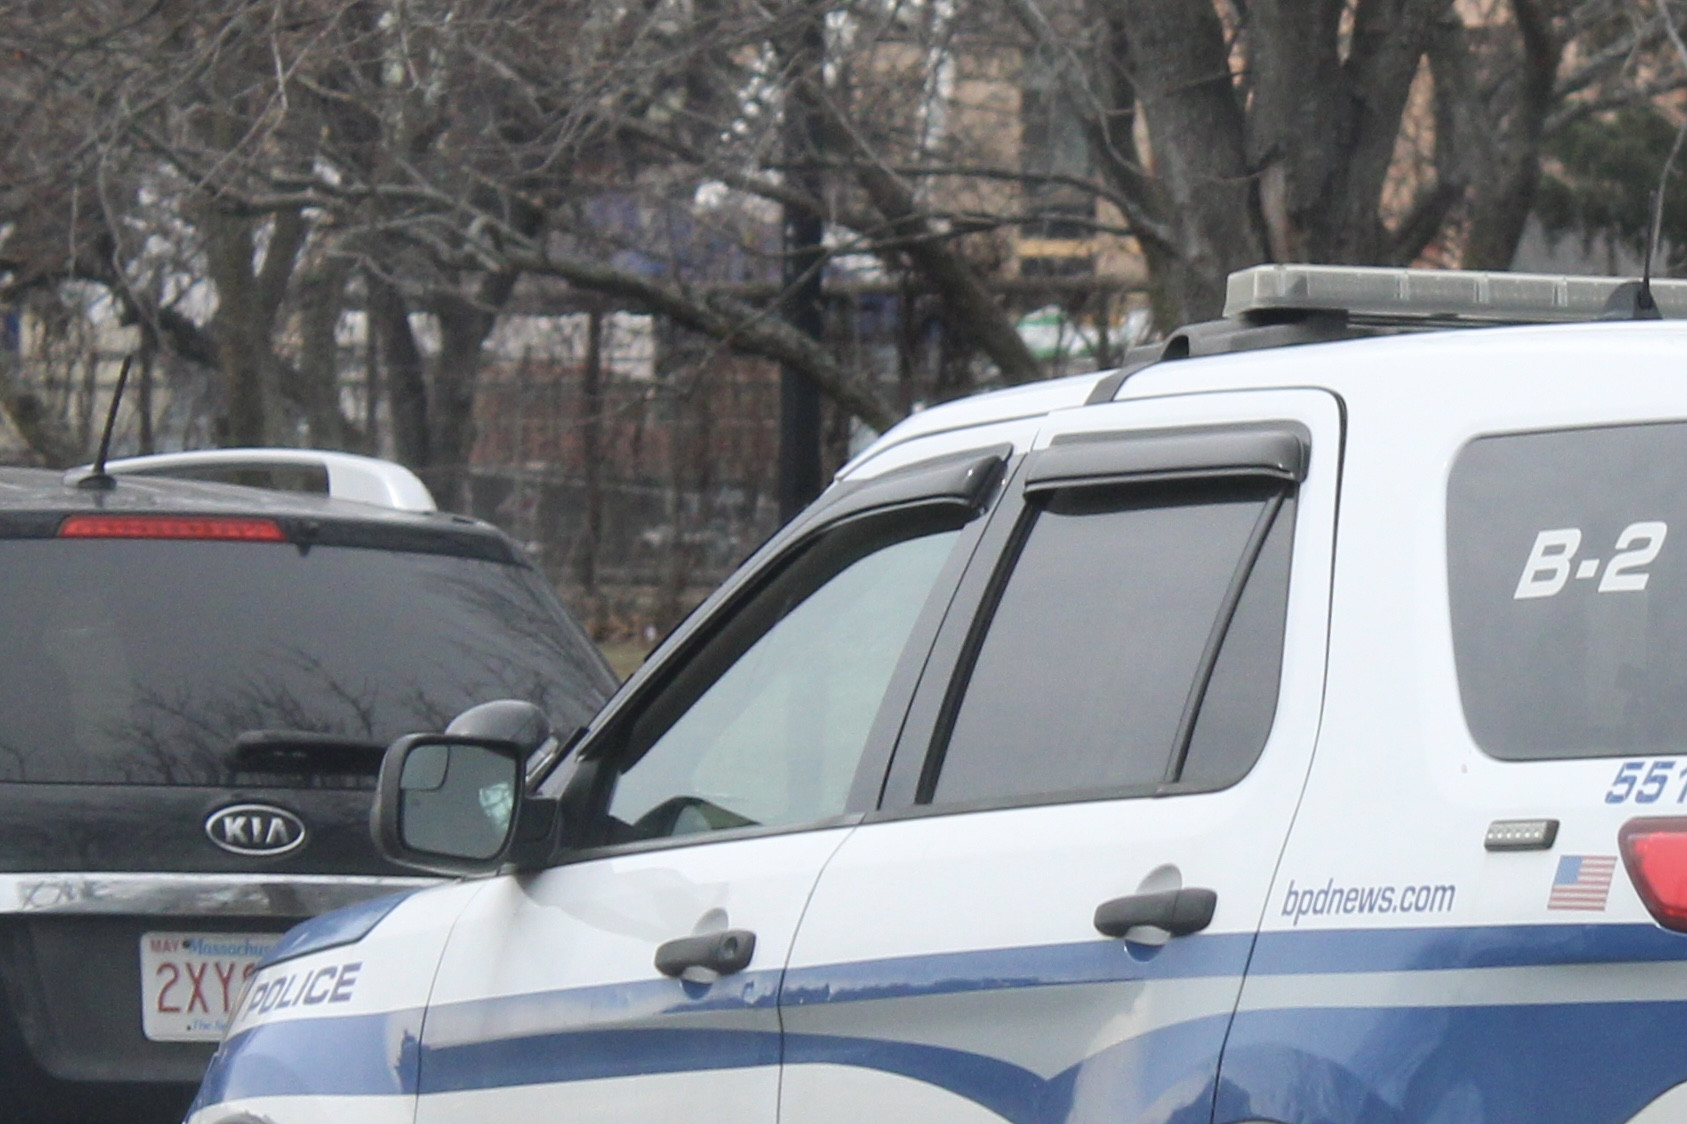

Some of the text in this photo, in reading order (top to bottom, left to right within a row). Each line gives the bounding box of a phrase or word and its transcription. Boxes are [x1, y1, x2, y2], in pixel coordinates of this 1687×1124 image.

[1513, 521, 1668, 600] B-2
[223, 816, 289, 844] KIA
[1281, 877, 1456, 926] bpdnews.com
[151, 939, 179, 953] MAY
[243, 960, 363, 1021] POLICE
